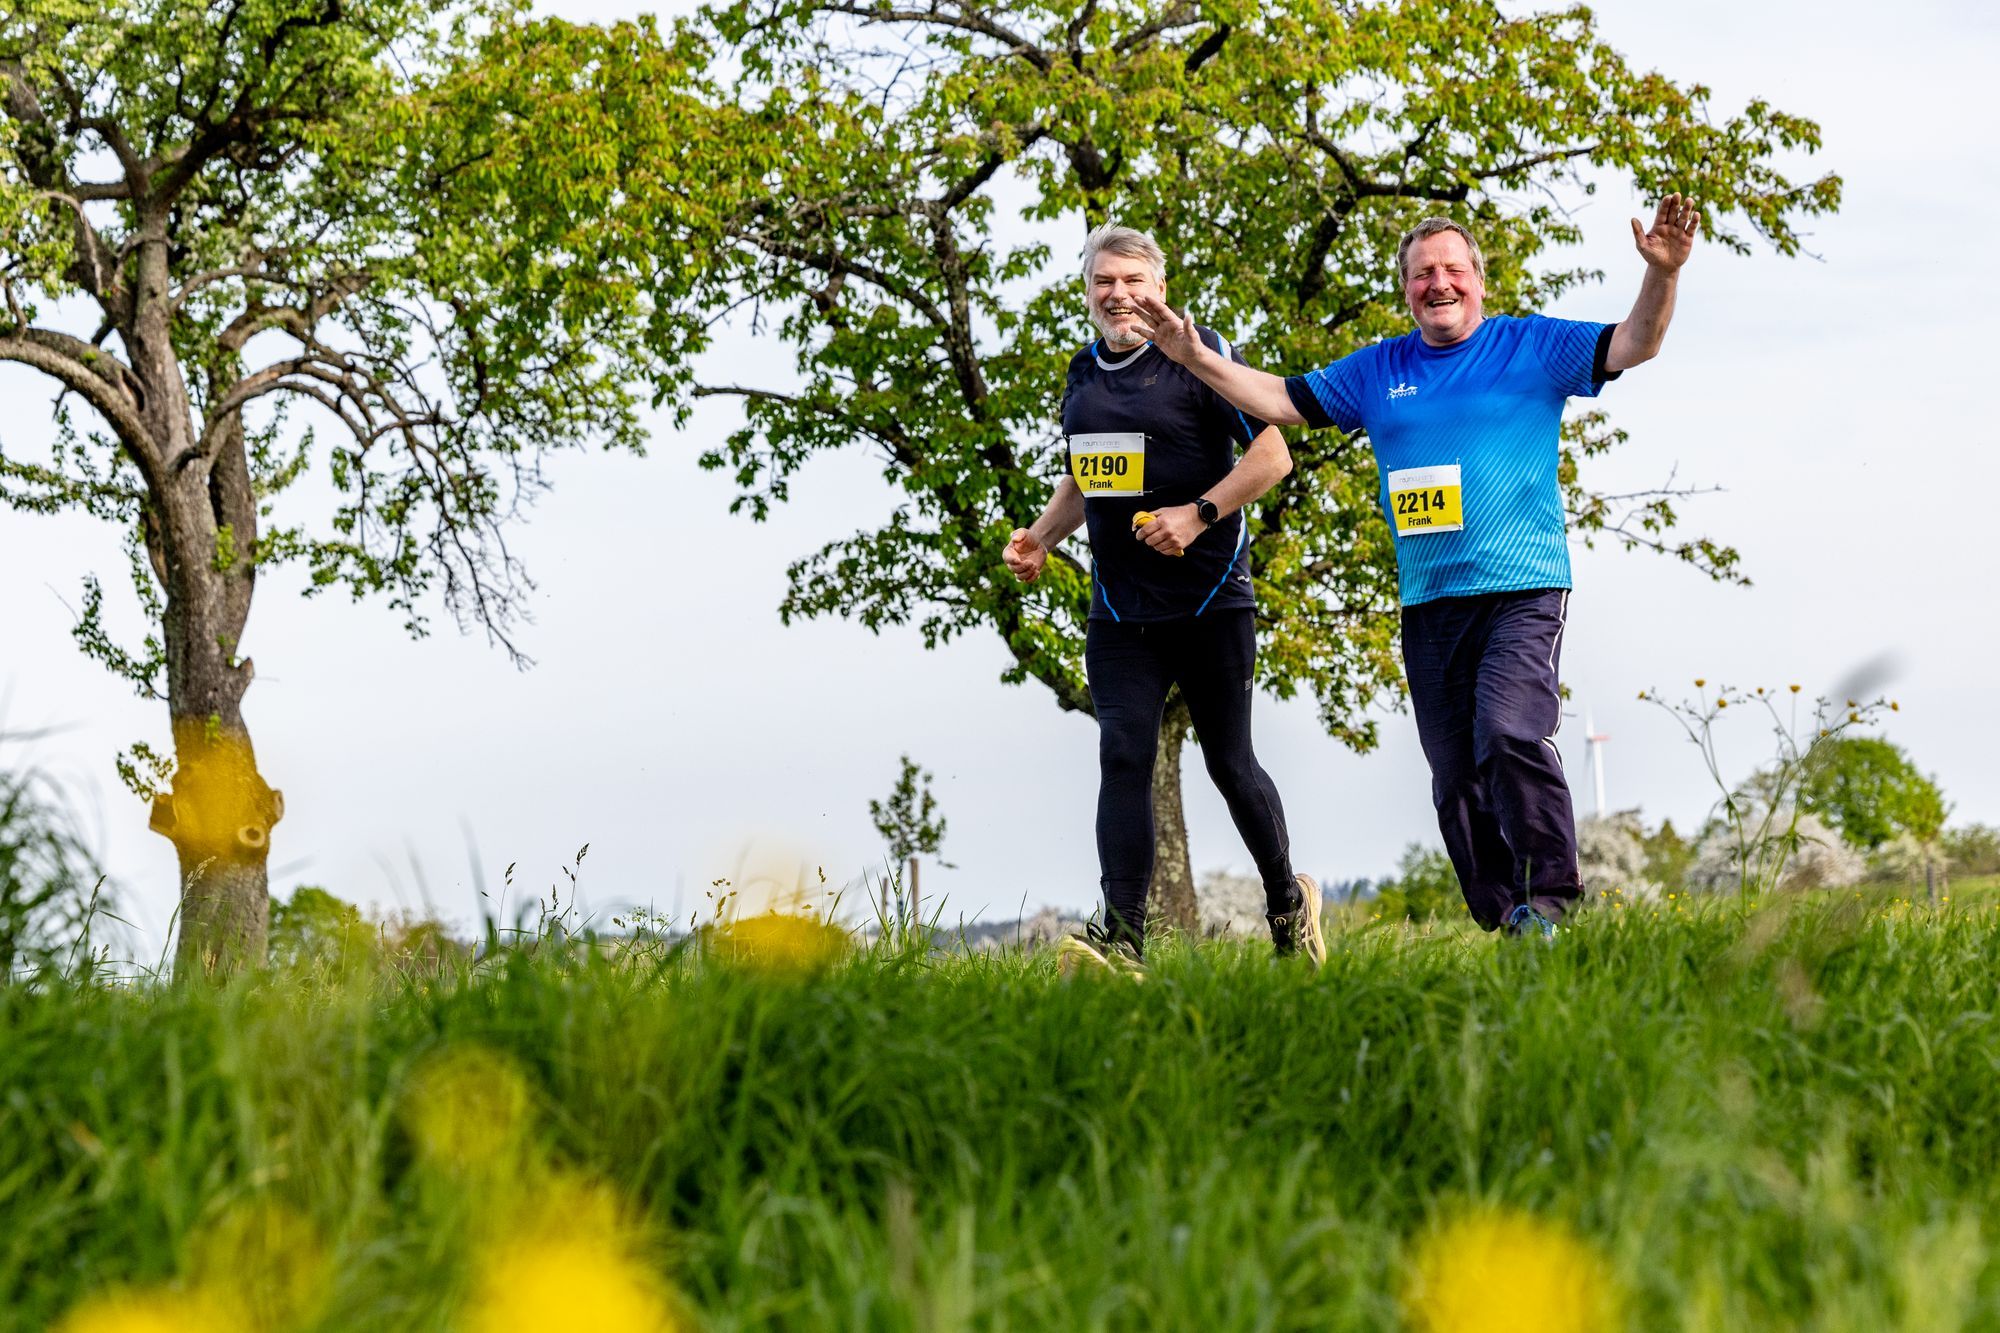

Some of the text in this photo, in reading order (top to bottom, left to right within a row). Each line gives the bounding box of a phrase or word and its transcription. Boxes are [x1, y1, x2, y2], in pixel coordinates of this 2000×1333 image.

[1079, 455, 1128, 477] 2190
[1089, 480, 1113, 489] Frank
[1397, 489, 1446, 515] 2214
[1408, 515, 1432, 527] Frank
